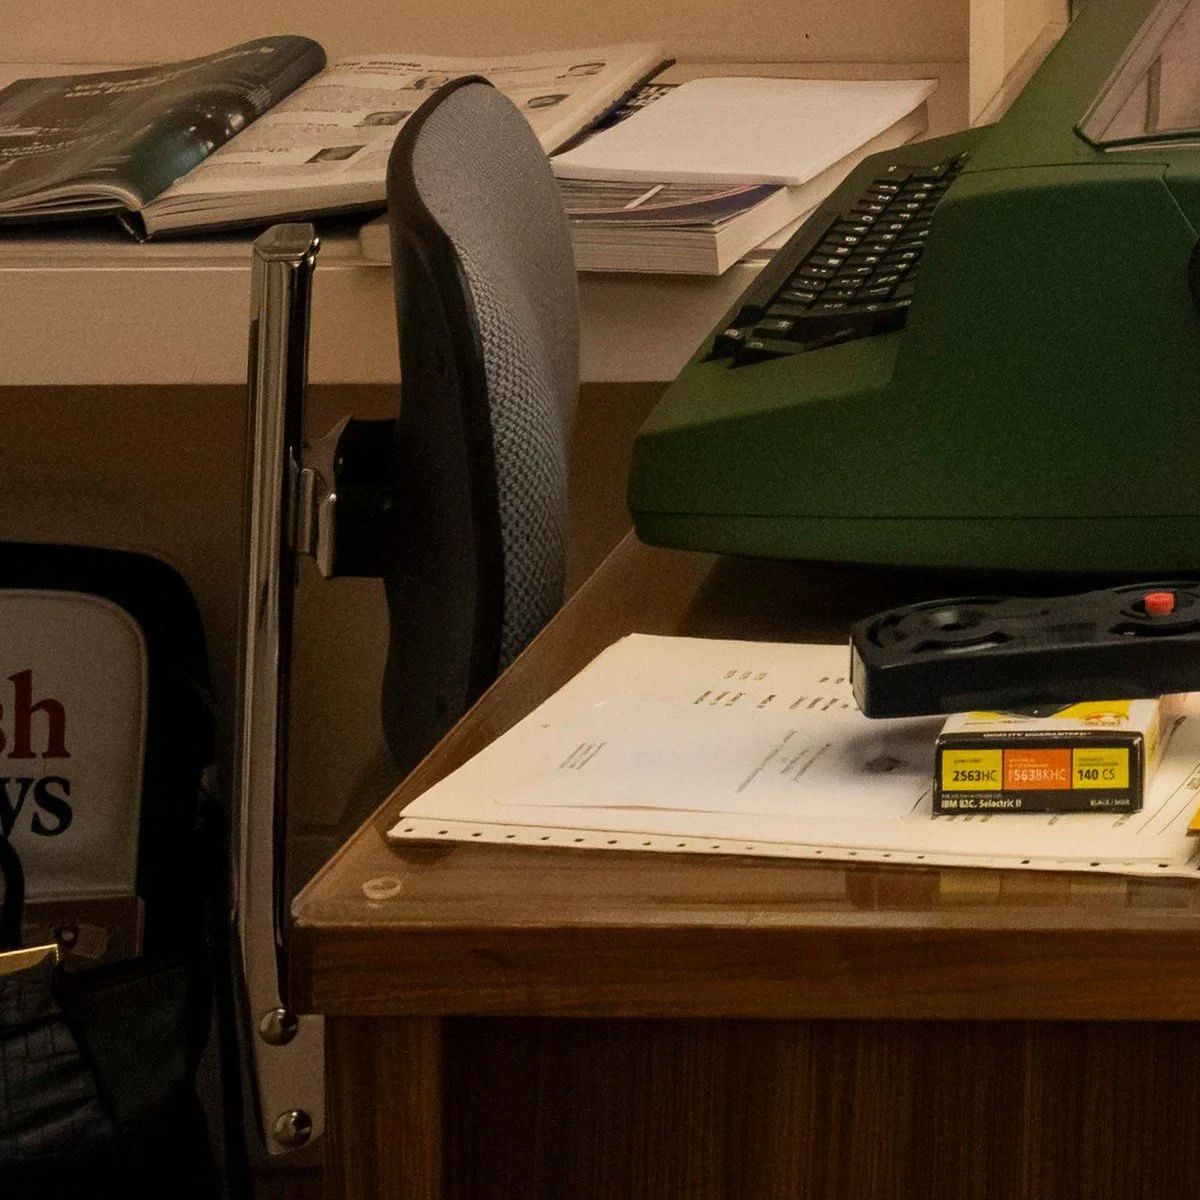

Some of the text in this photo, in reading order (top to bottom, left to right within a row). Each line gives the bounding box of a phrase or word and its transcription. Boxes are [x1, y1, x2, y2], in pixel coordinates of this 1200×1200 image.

[953, 771, 997, 782] 2563HC
[1078, 769, 1098, 780] 140
[941, 799, 956, 808] IBM
